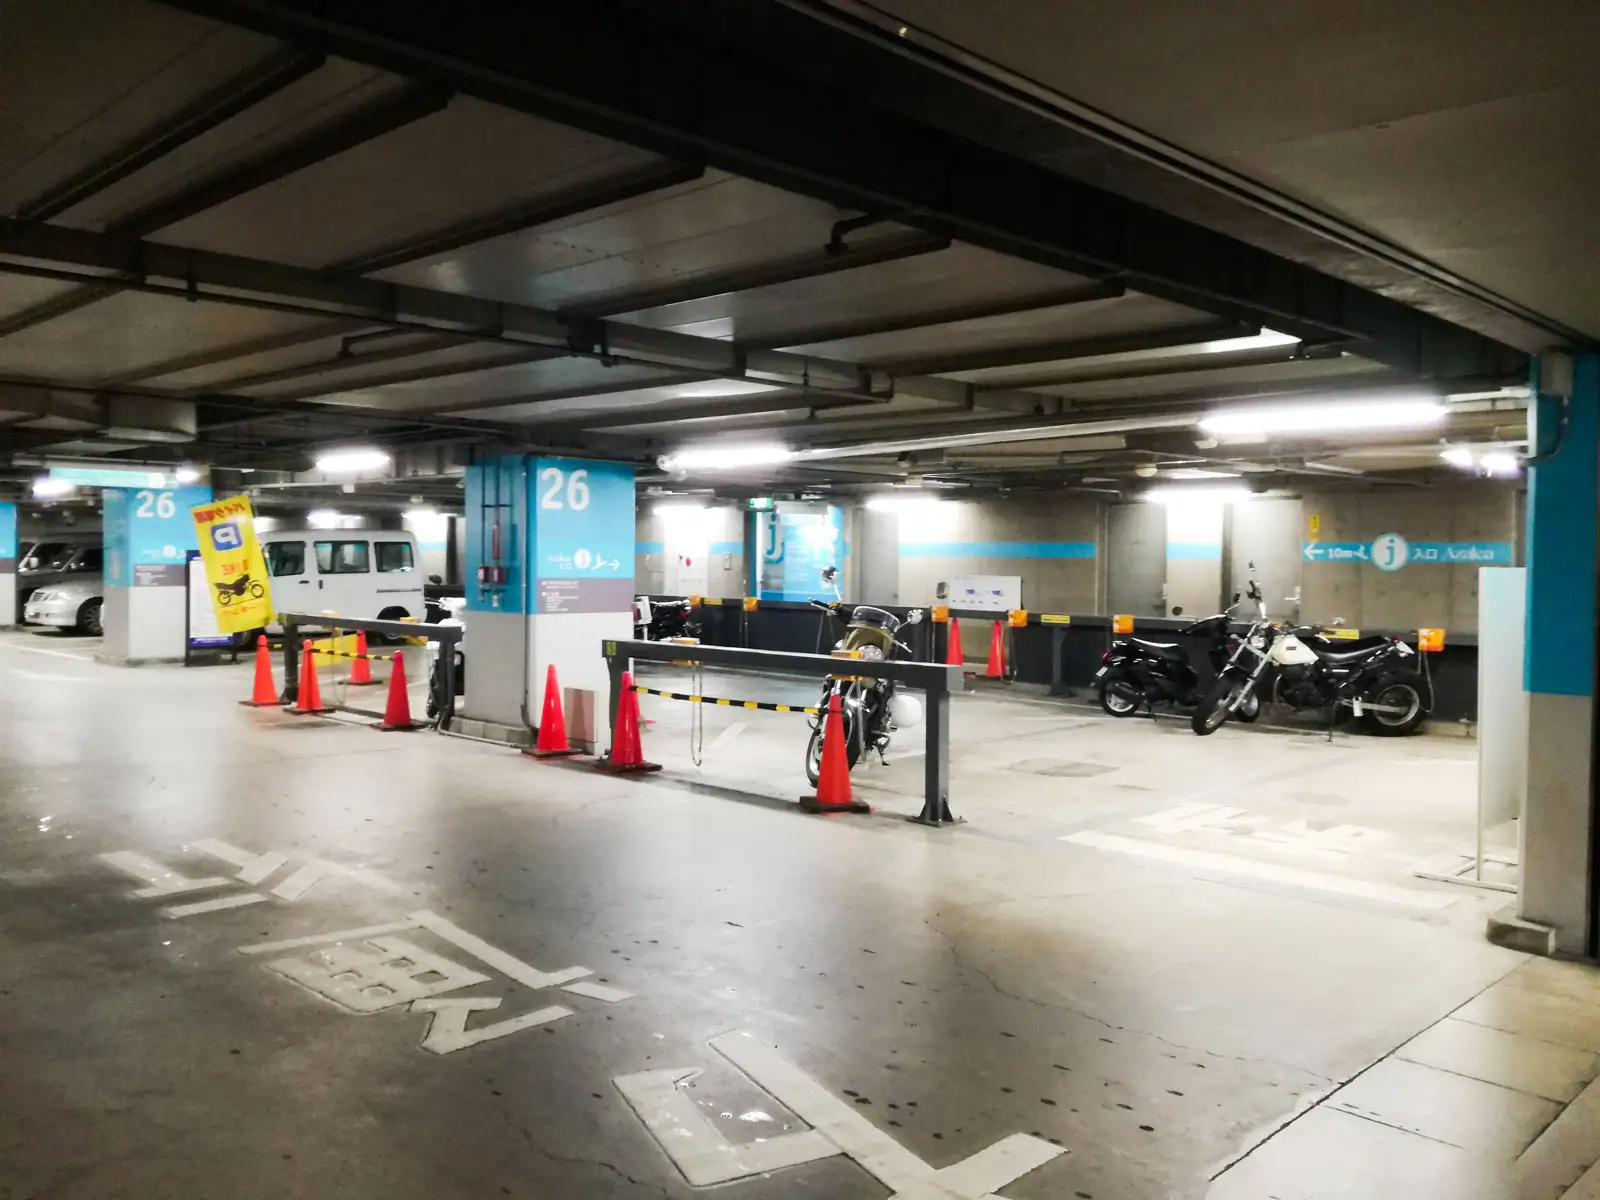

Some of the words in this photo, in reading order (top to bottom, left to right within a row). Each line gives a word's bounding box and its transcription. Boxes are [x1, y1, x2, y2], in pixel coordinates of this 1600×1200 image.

[541, 467, 590, 511] 26
[136, 490, 176, 519] 26
[1412, 547, 1438, 560] 入口
